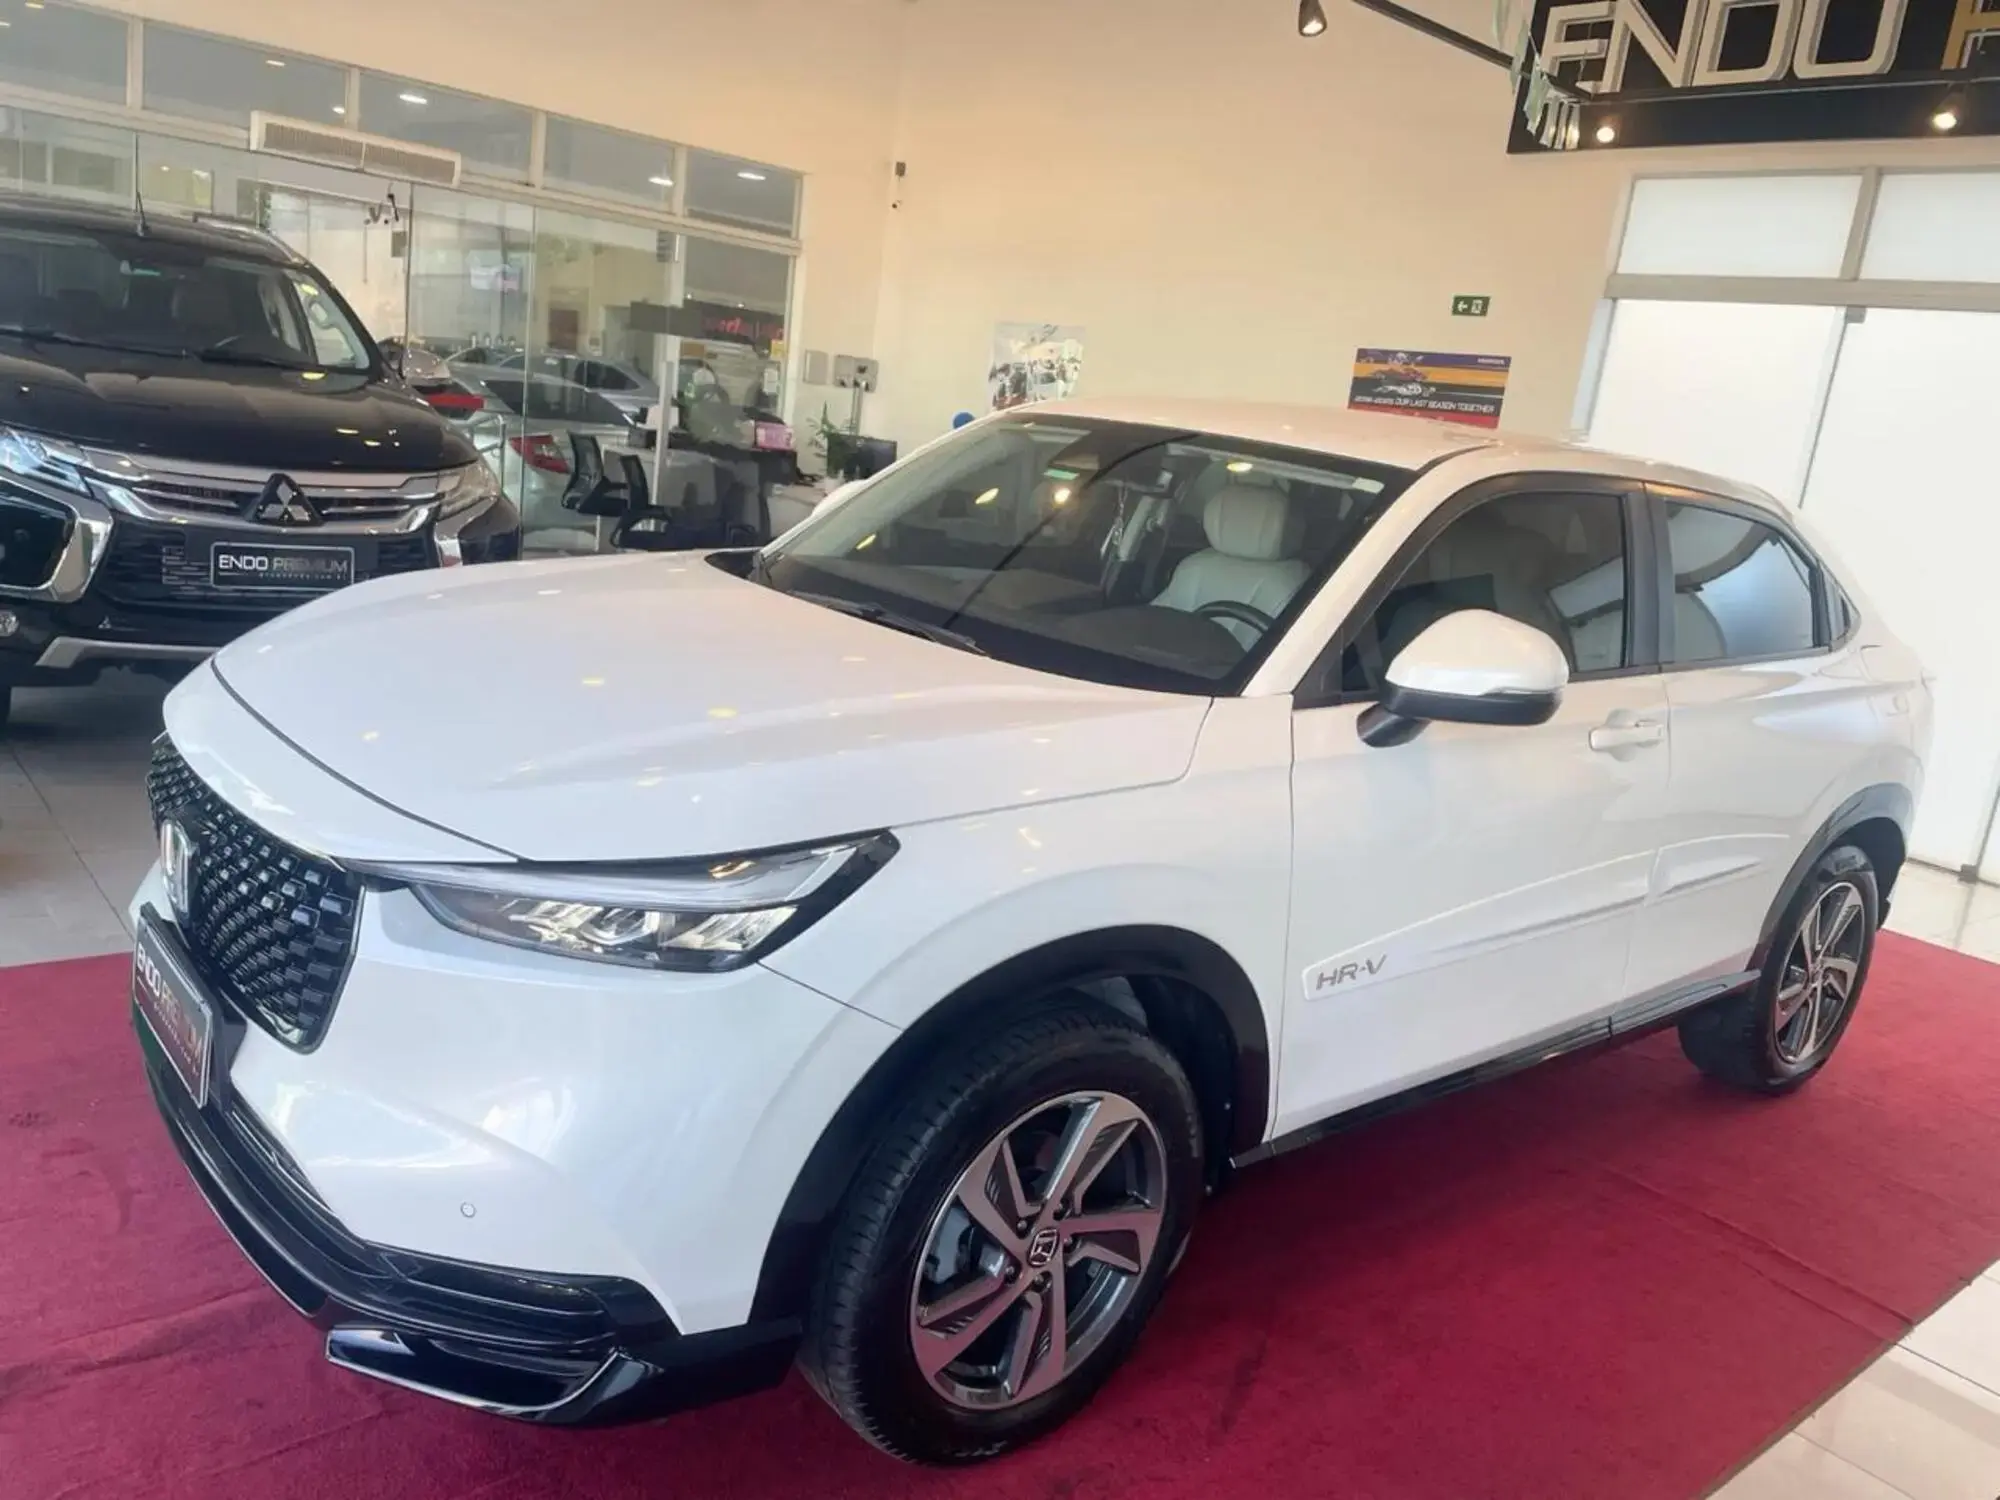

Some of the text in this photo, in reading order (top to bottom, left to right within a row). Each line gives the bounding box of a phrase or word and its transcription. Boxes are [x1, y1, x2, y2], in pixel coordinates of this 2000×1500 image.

[218, 554, 348, 573] ENDO PREMIUM
[1316, 953, 1387, 991] HR-V
